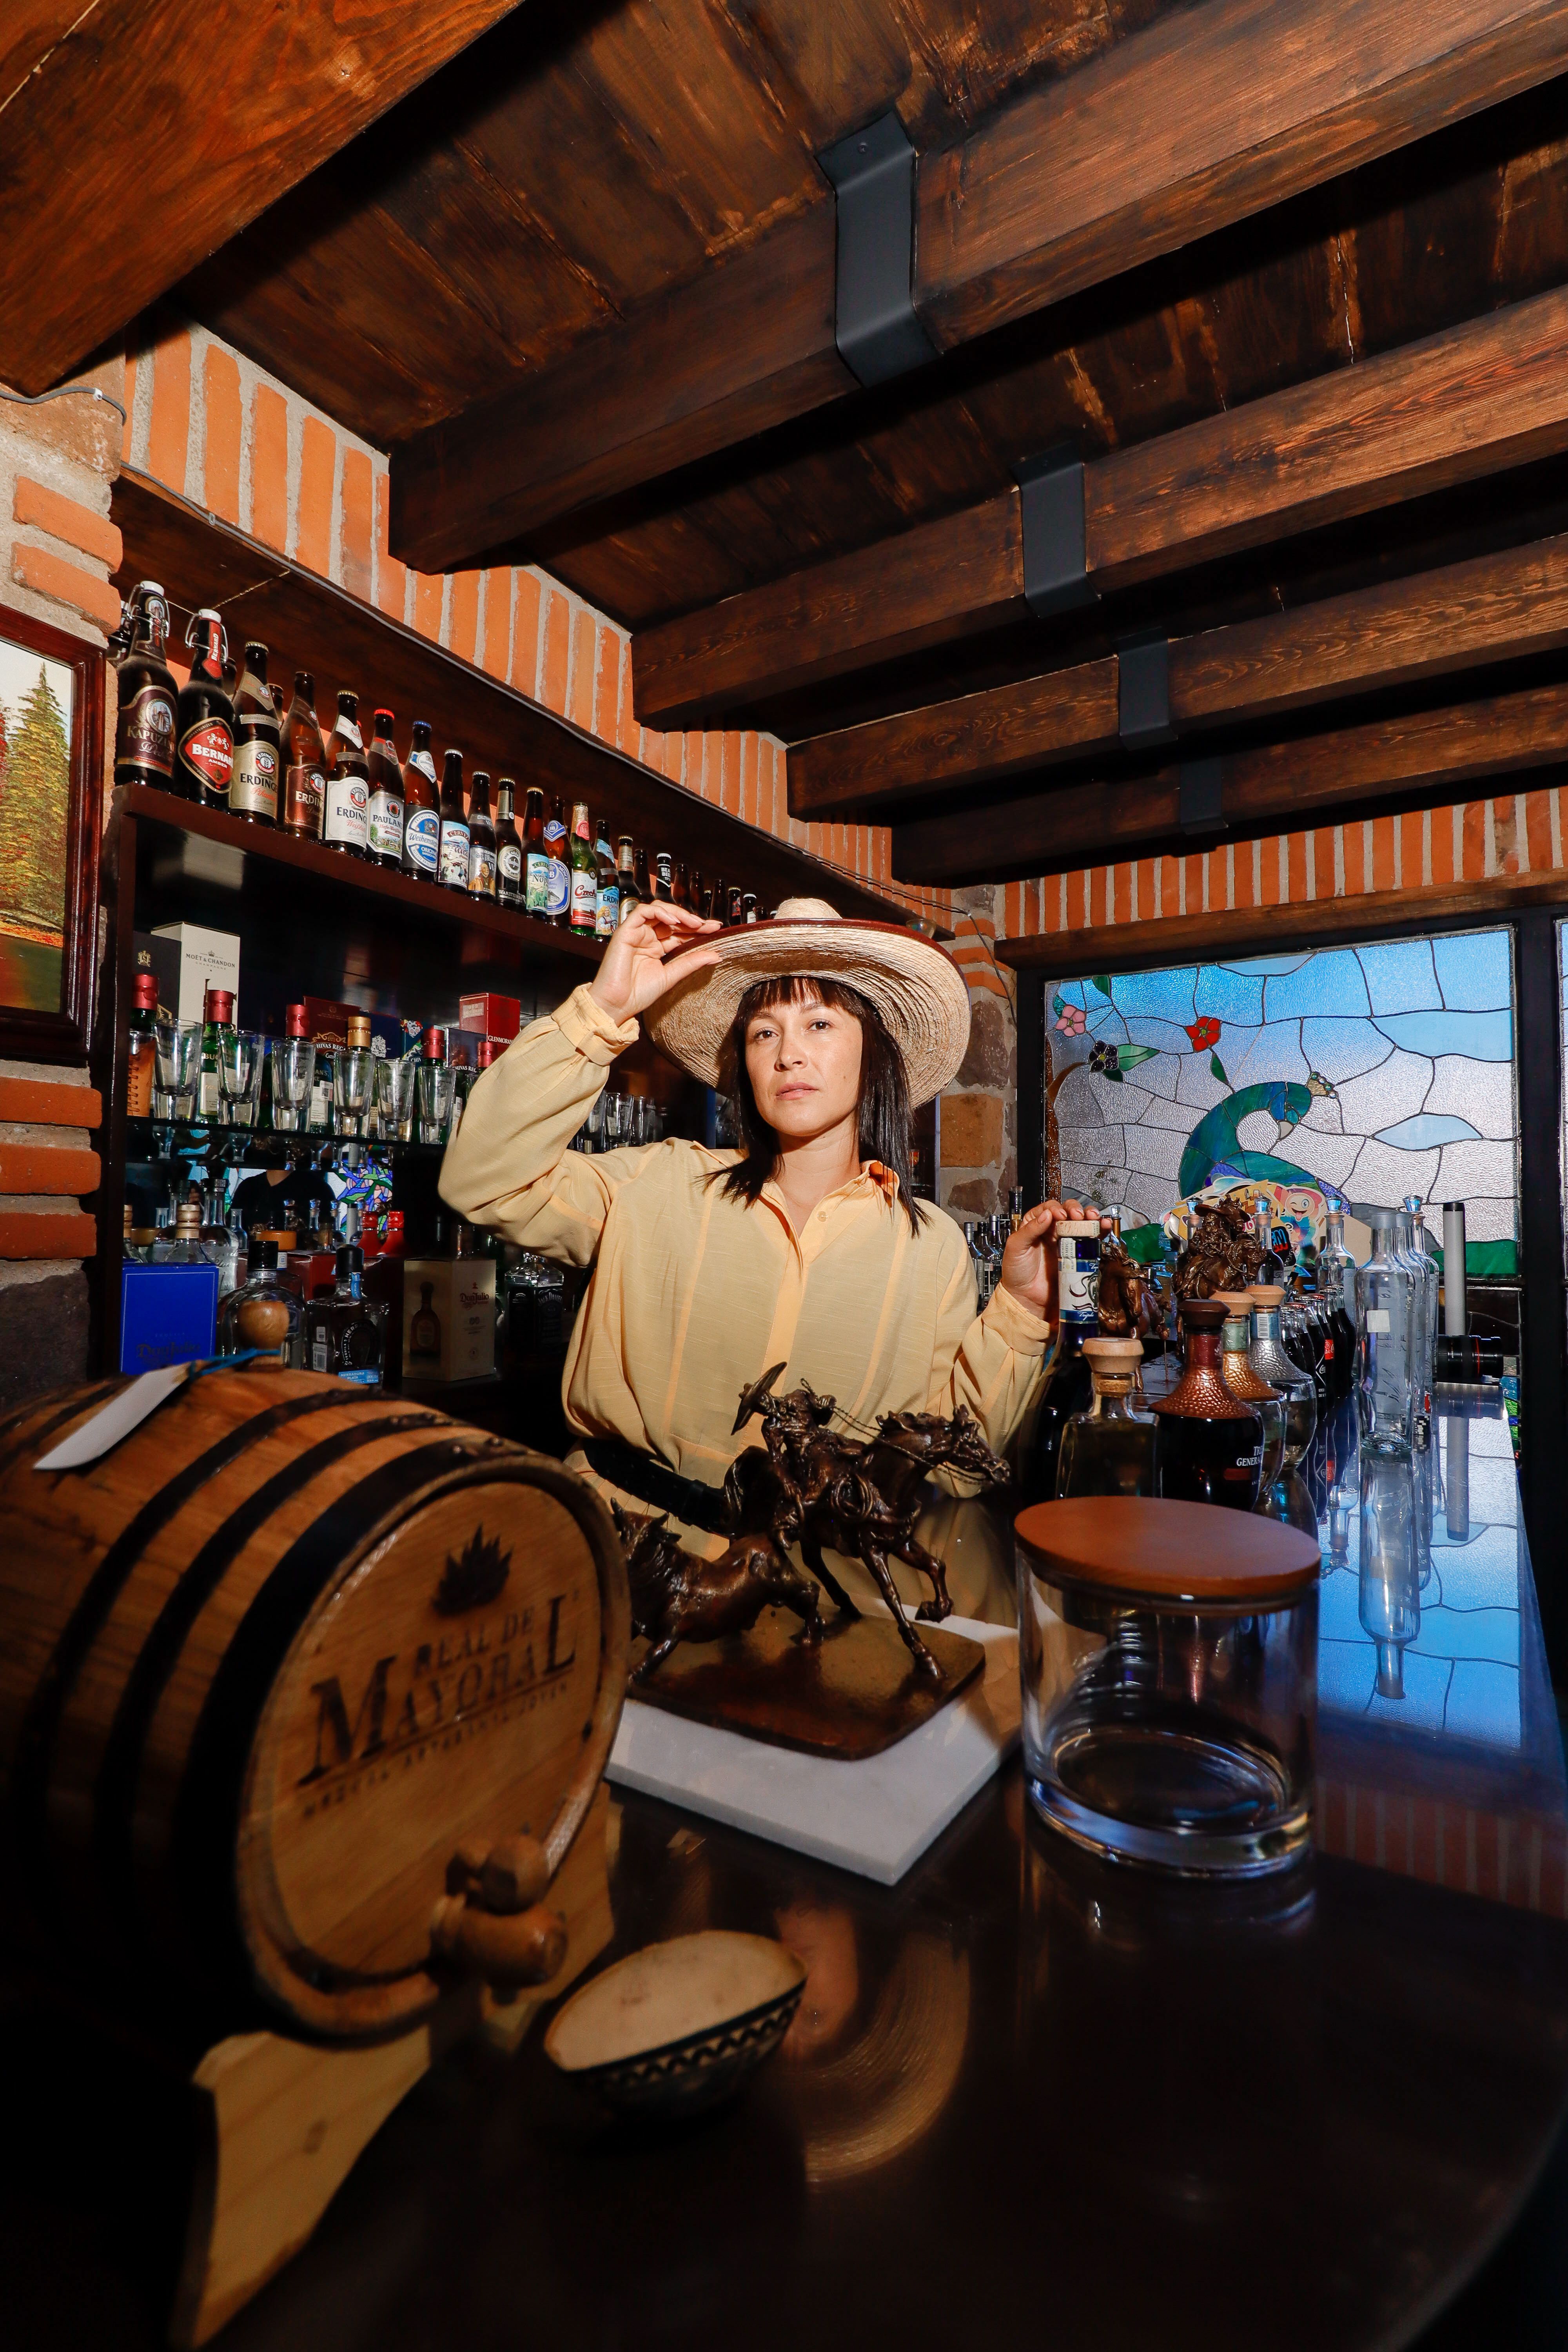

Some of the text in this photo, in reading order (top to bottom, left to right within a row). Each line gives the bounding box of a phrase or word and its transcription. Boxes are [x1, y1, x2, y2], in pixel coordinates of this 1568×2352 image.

[211, 633, 219, 662] BERNARD
[208, 759, 227, 769] AMBER
[186, 952, 202, 961] MOËT
[207, 957, 236, 969] CHANDON
[501, 1605, 535, 1646] DE
[296, 1594, 577, 1788] MAYORAL
